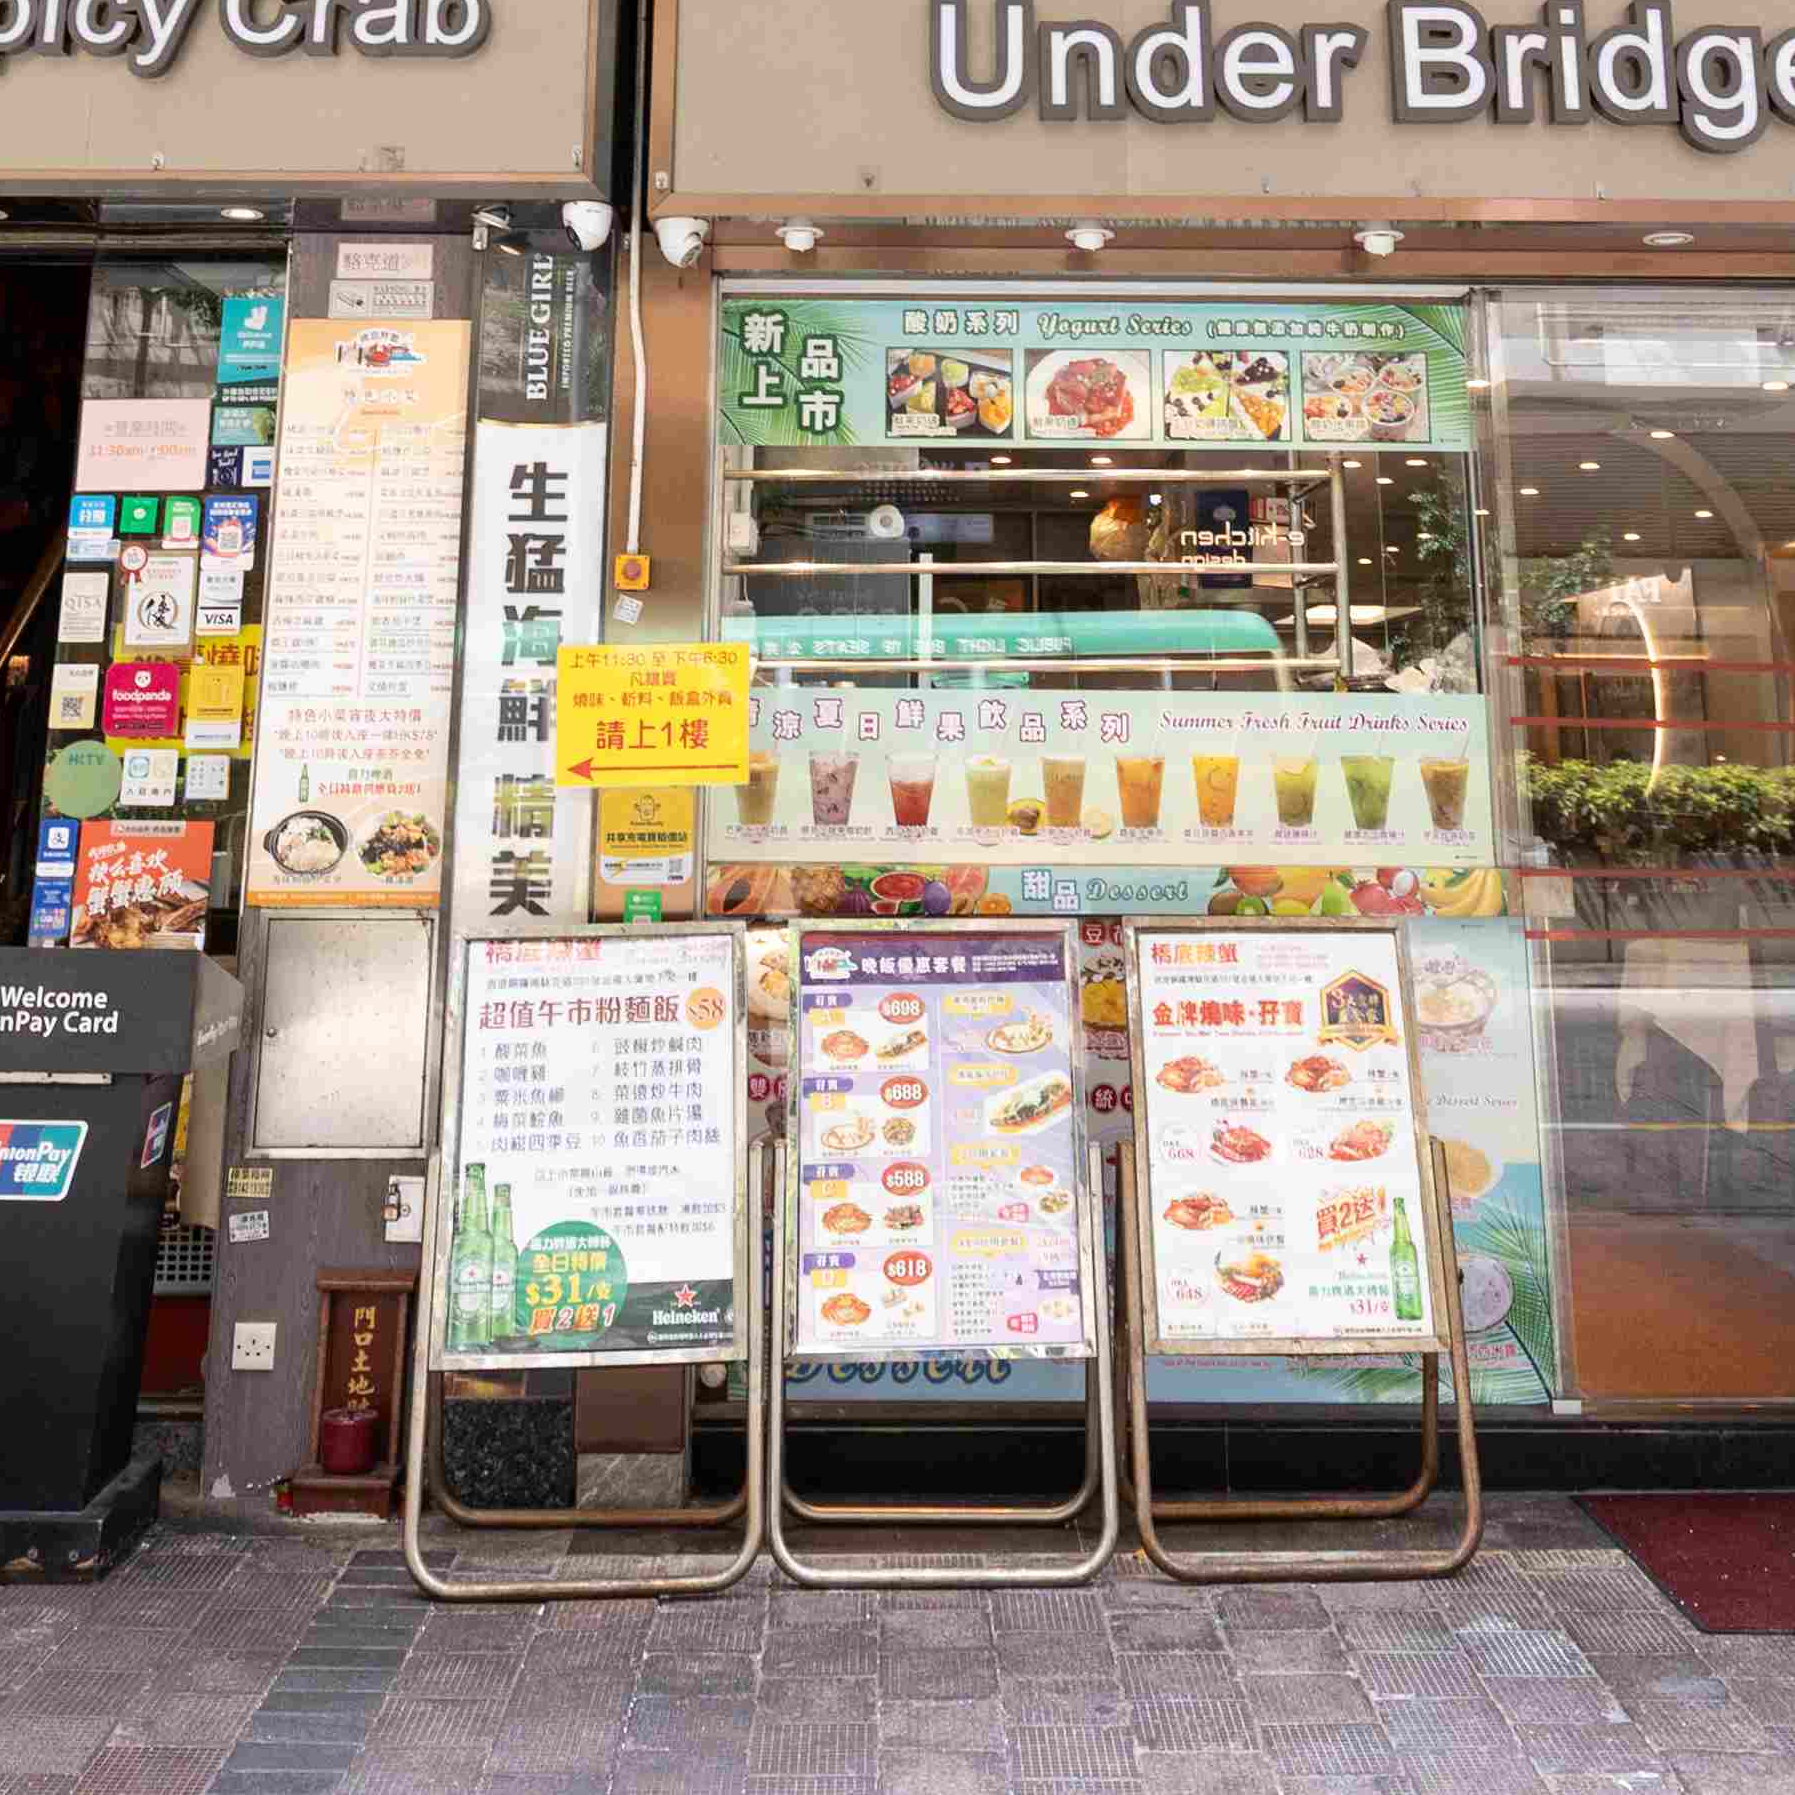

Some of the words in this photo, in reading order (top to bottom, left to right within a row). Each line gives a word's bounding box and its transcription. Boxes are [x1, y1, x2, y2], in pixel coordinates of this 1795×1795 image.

[530, 255, 554, 325] GIRL
[903, 308, 1020, 336] 酸奶系列
[1037, 313, 1121, 341] Yogurt
[1125, 314, 1193, 336] Series
[526, 327, 550, 401] BLUE
[497, 462, 568, 742] 生猛海鮮
[205, 613, 234, 625] VISA
[112, 689, 172, 703] foodpanda
[1159, 709, 1234, 732] Summer
[1239, 709, 1290, 732] Fresh
[1295, 709, 1343, 732] Fruit
[1347, 711, 1412, 732] Drinks
[1415, 710, 1470, 732] Series
[596, 718, 710, 751] 請上1樓
[1021, 868, 1081, 912] 甜品
[1085, 876, 1190, 902] Dessert
[0, 985, 109, 1009] Welcome
[63, 1010, 119, 1034] Card
[652, 1308, 720, 1327] Heineken
